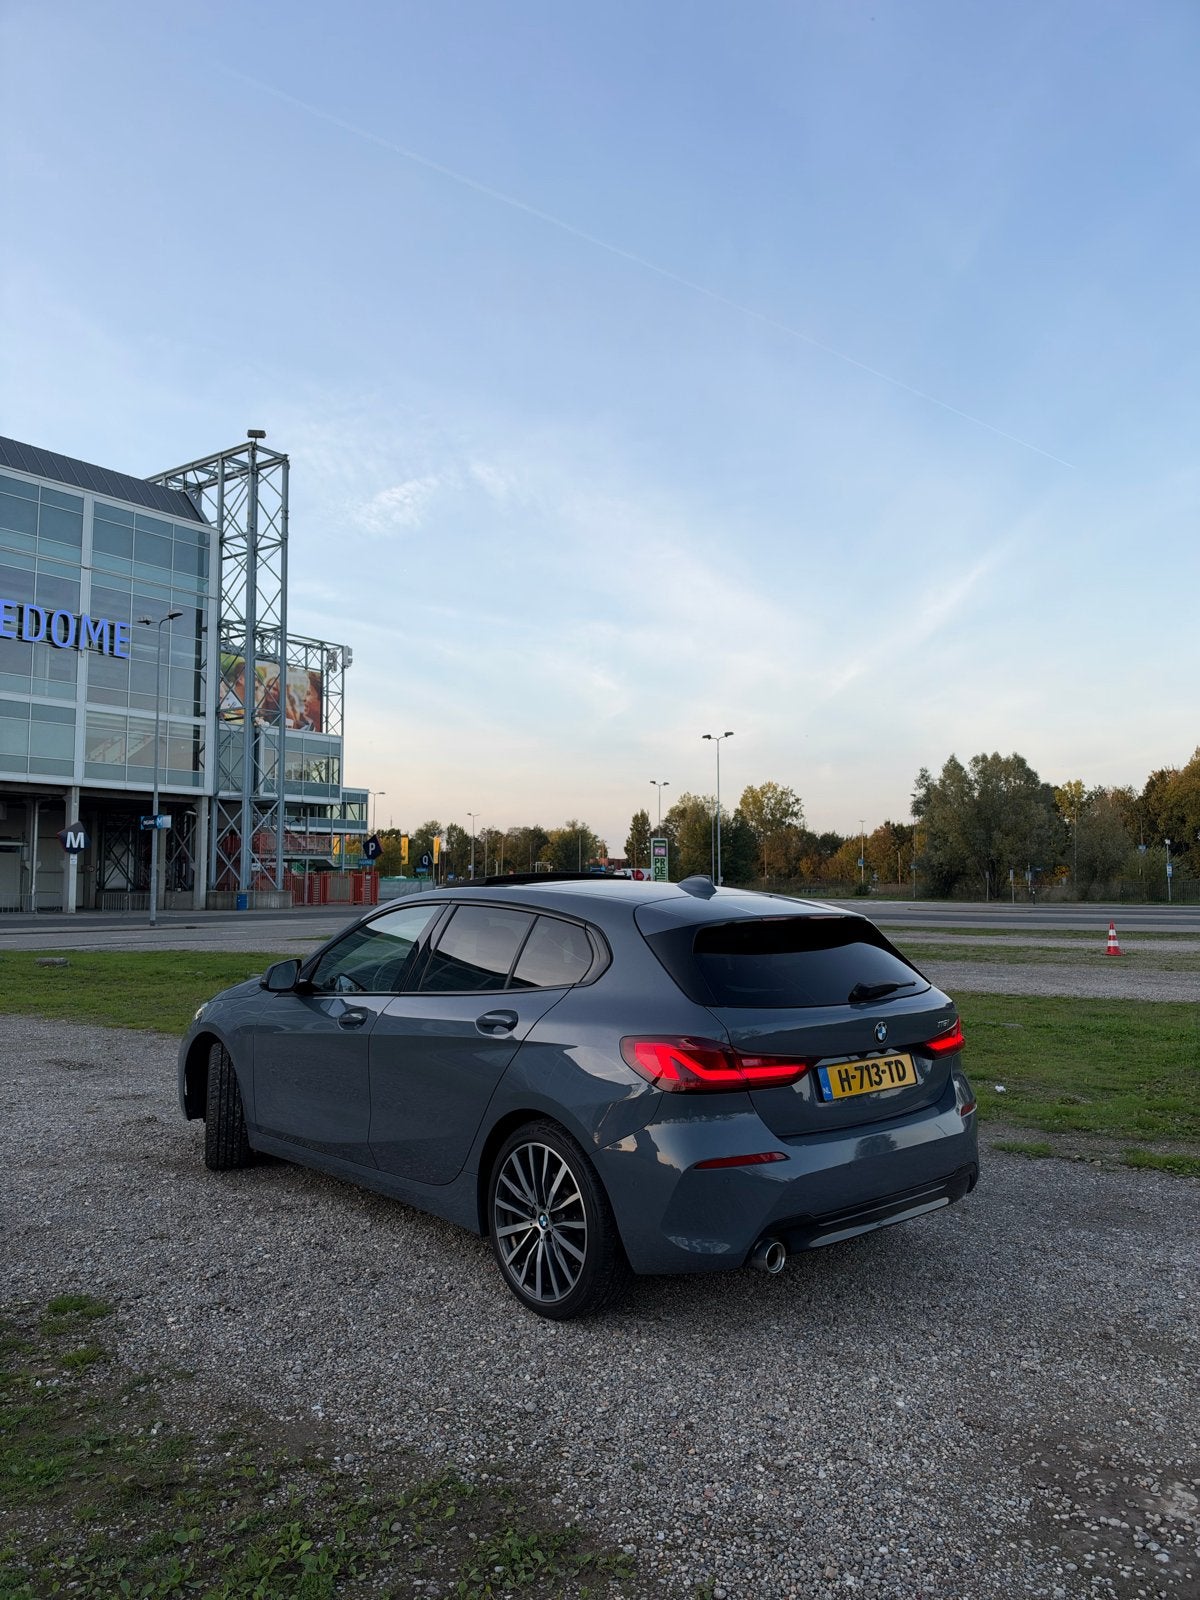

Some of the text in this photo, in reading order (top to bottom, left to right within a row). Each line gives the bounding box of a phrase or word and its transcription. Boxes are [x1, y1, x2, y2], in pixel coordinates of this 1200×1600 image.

[0, 599, 131, 658] EDOME
[66, 832, 85, 848] M
[369, 842, 376, 855] P
[422, 855, 429, 865] Q
[838, 1059, 907, 1092] H-713-TD
